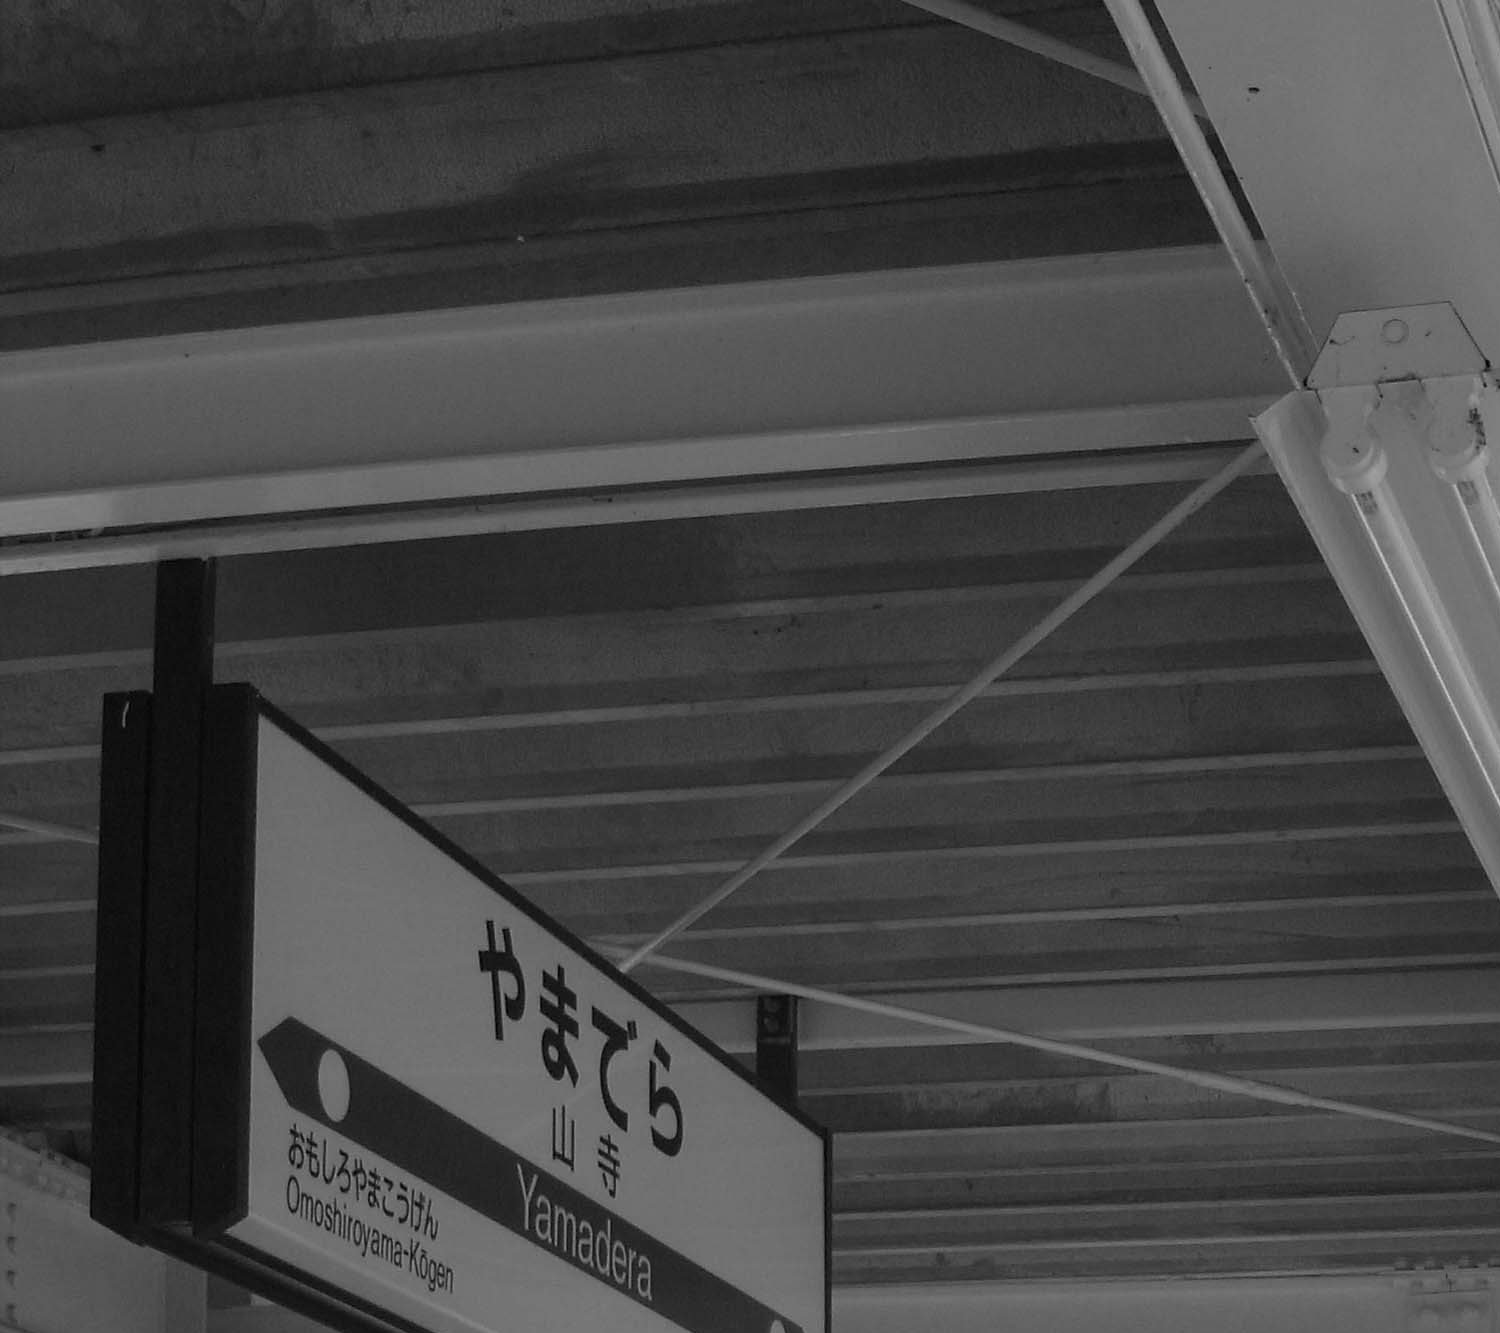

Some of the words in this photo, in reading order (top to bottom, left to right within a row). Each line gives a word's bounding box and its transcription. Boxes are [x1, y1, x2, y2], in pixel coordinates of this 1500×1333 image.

[478, 919, 684, 1158] やまでら
[288, 1123, 440, 1242] おもしろやまこうげん
[551, 1103, 621, 1198] 山寺
[285, 1175, 454, 1295] Omoshiroyama-Kōgen
[516, 1162, 653, 1300] Yamadera
